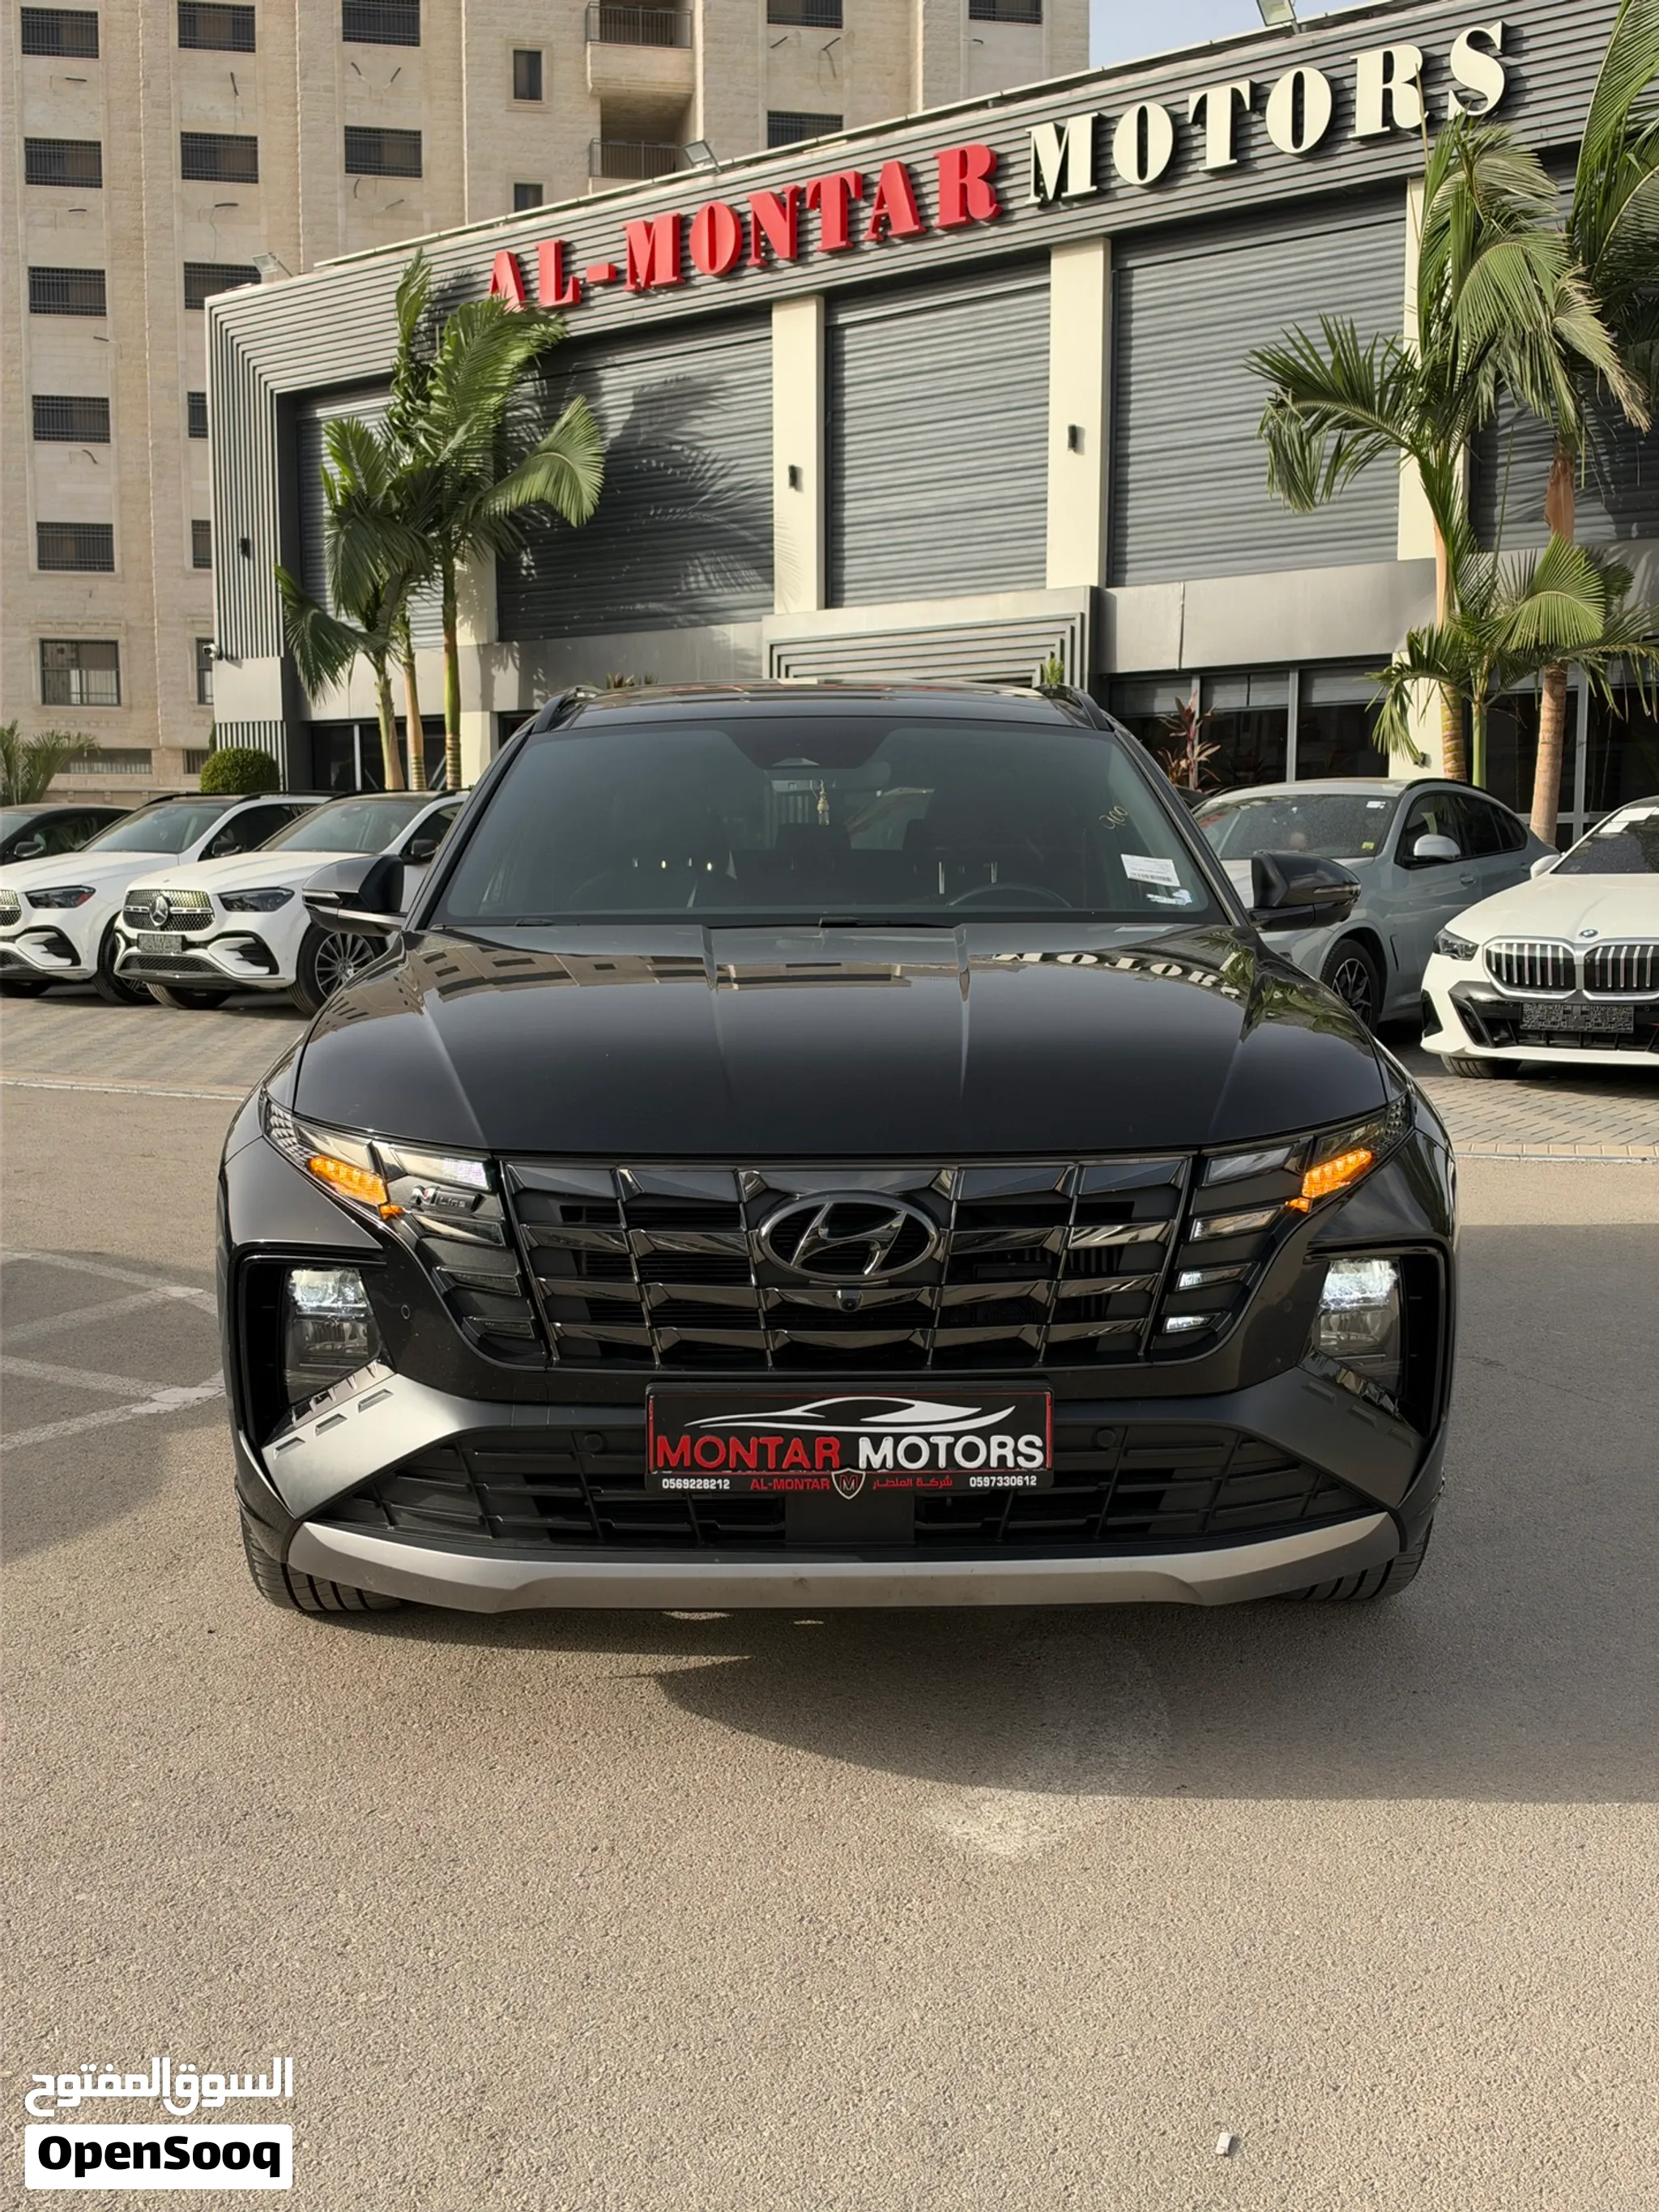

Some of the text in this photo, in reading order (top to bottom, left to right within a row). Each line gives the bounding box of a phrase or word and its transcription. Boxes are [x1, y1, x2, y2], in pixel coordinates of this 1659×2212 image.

[489, 20, 1509, 311] AL-MONTAR MOTORS
[657, 1434, 1044, 1470] MONTAR MOTORS
[662, 1477, 730, 1490] 0569228212
[750, 1477, 830, 1490] AL-MONTAR
[970, 1475, 1037, 1487] 0597330612
